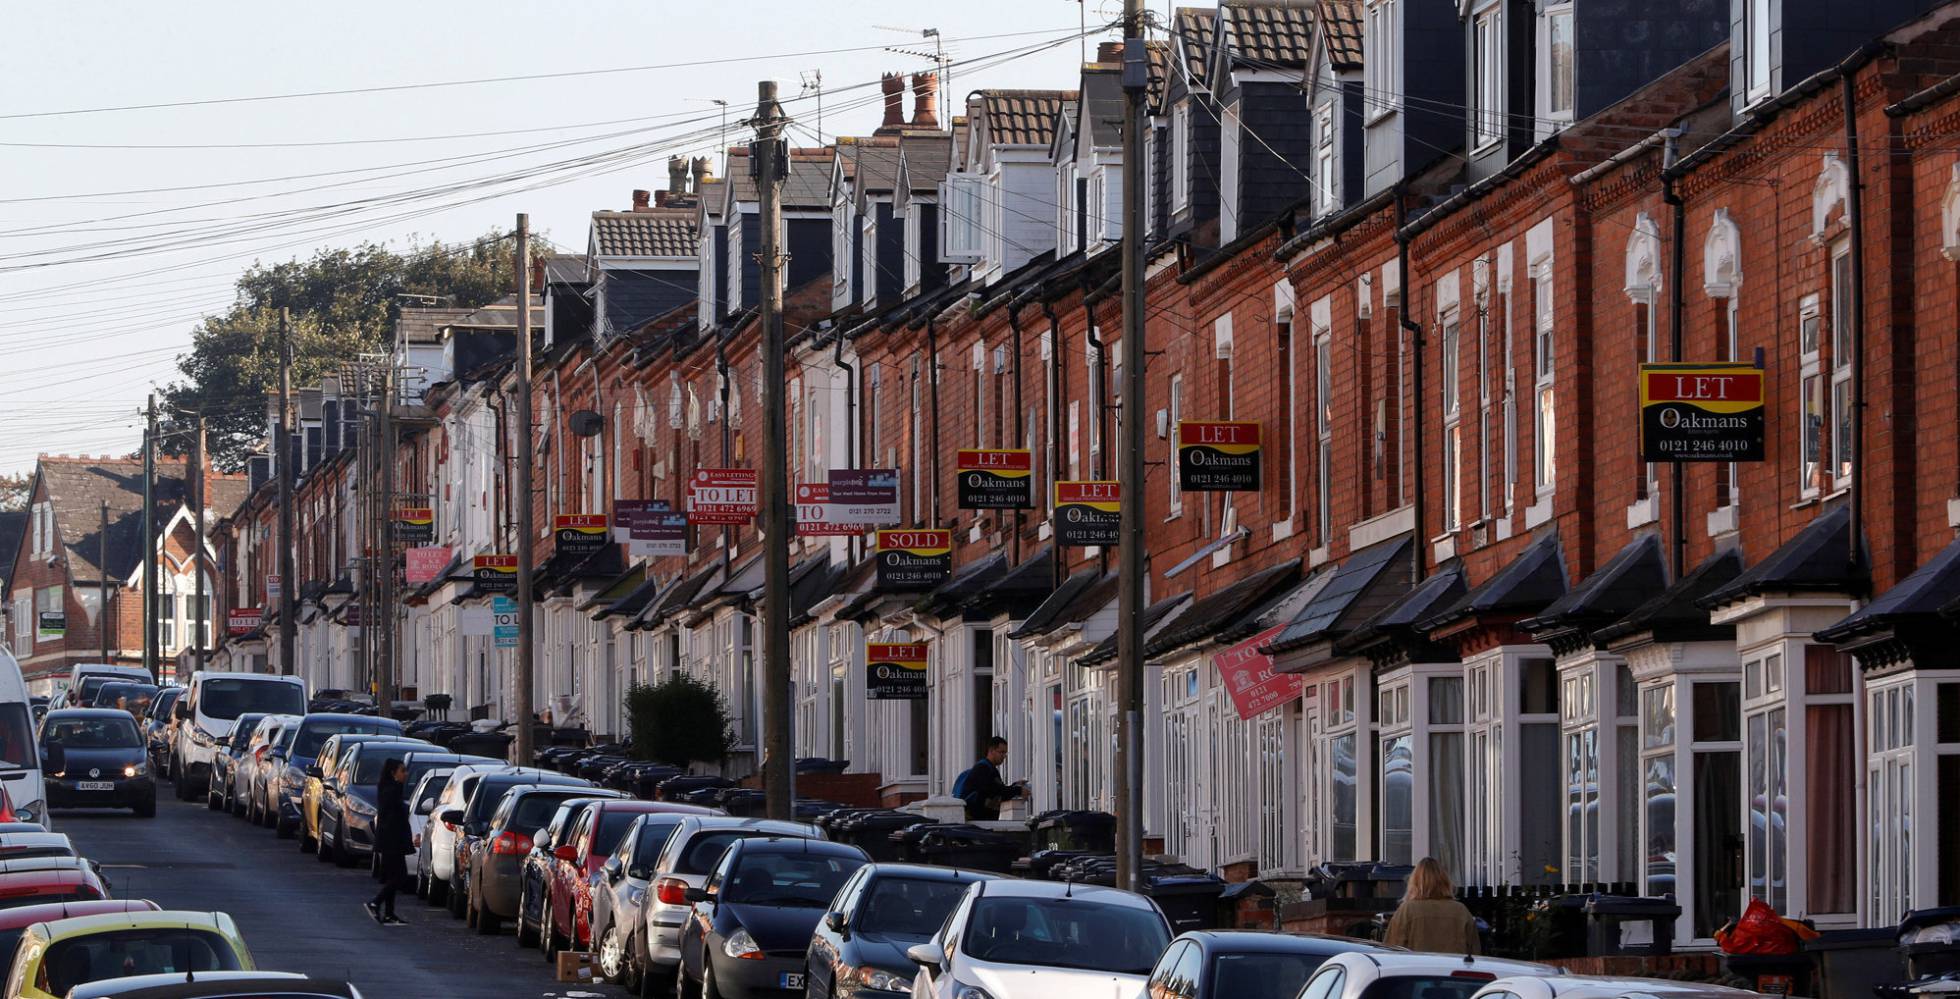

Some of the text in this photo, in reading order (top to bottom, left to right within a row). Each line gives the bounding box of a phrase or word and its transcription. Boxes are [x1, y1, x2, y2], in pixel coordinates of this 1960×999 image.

[1675, 376, 1733, 399] LET
[1660, 407, 1748, 429] Oakmans
[1200, 425, 1240, 443] LET
[1660, 440, 1748, 451] 0121 246 4010
[978, 453, 1011, 465] LET
[1190, 449, 1252, 466] Oakmans
[968, 473, 1025, 488] Oakmans
[1190, 474, 1252, 483] 0121 246 4010
[698, 489, 755, 502] TO LET
[1080, 484, 1117, 497] LET
[968, 494, 1026, 503] 0121 246 4010
[697, 504, 757, 512] 0121 472 6969
[799, 506, 823, 520] TO
[570, 516, 590, 525] LET
[799, 522, 864, 531] 0121 472 6969
[562, 530, 602, 541] Oakmans
[1066, 530, 1119, 539] 0121 246 40
[889, 533, 939, 548] SOLD
[486, 557, 507, 566] LET
[886, 552, 941, 566] Oakmans
[886, 572, 942, 580] 0121 246 4010
[495, 614, 511, 625] TO
[888, 646, 919, 657] LET
[1234, 645, 1257, 662] TO
[876, 665, 927, 679] Oakman
[788, 976, 804, 987] EX
